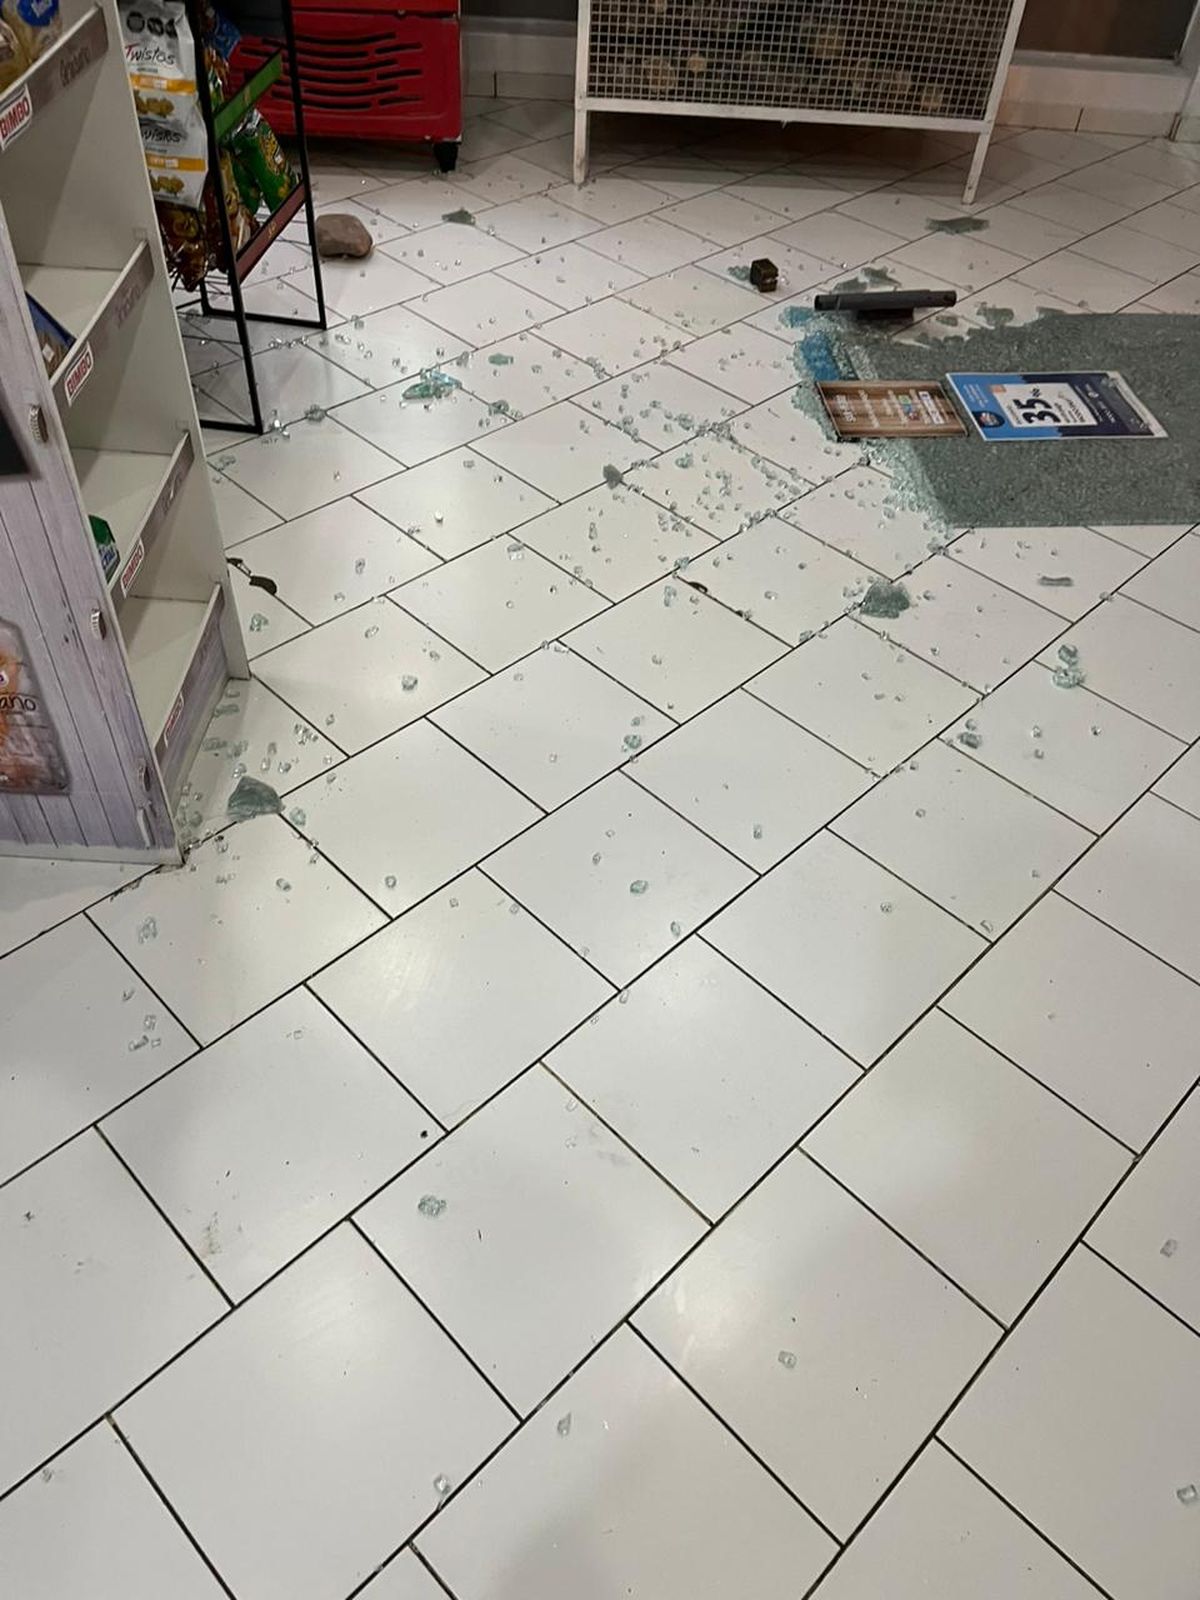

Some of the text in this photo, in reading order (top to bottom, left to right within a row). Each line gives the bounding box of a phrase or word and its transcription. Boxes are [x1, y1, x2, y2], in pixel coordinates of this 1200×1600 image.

[125, 43, 176, 65] Twistos
[0, 97, 30, 138] BIMBO
[66, 352, 92, 397] BIMBO
[1014, 398, 1062, 424] 35
